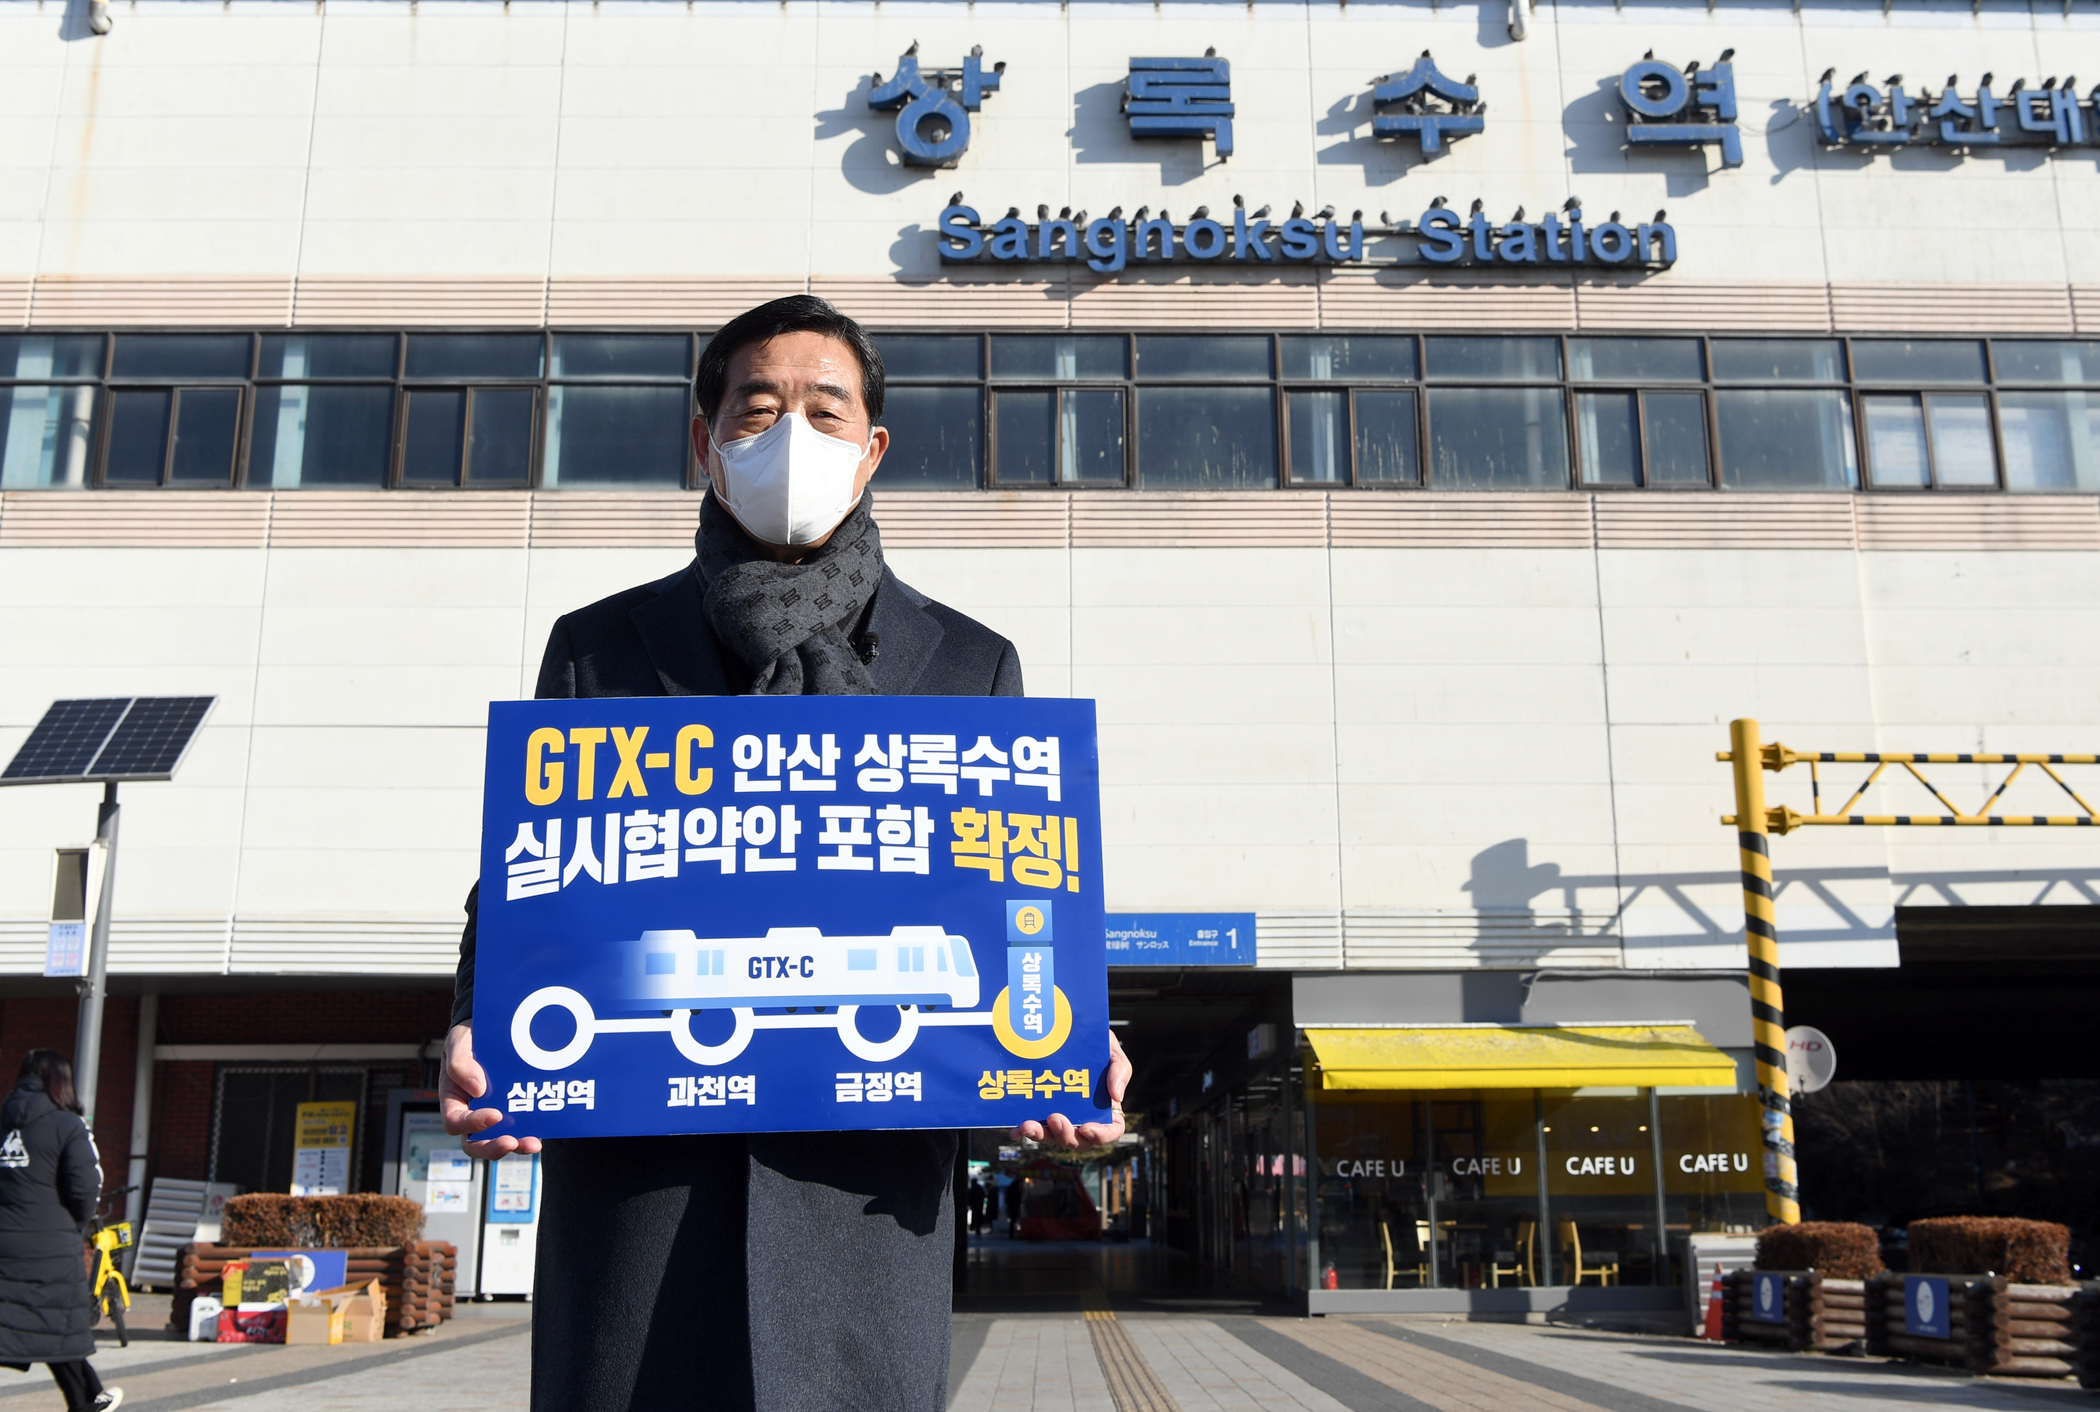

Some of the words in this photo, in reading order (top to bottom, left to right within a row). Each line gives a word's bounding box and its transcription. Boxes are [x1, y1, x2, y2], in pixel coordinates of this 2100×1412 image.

[1818, 82, 2100, 144] (안산대
[937, 205, 1363, 272] Sangnoksu
[1418, 208, 1677, 263] Station
[525, 724, 714, 806] GTX-C
[733, 734, 840, 792] 안산
[854, 734, 1061, 801] 상록수역
[505, 804, 801, 901] 실시협약안
[818, 804, 935, 875] 포함
[951, 806, 1079, 893] 확정!
[1226, 928, 1237, 949] 1
[748, 956, 814, 979] GTX-C
[1022, 952, 1043, 1034] 상록수역
[1789, 1041, 1822, 1052] HD
[508, 1080, 595, 1112] 삼성역
[667, 1075, 756, 1107] 과천역
[835, 1072, 922, 1102] 금정역
[978, 1069, 1090, 1099] 상록수역
[1336, 1160, 1385, 1177] CAFE
[1391, 1160, 1404, 1177] U
[1452, 1158, 1501, 1175] CAFE
[1507, 1157, 1521, 1175] U
[1565, 1156, 1615, 1175] CAFE
[1620, 1156, 1635, 1175] U
[1679, 1153, 1729, 1173] CAFE
[1733, 1153, 1748, 1172] U
